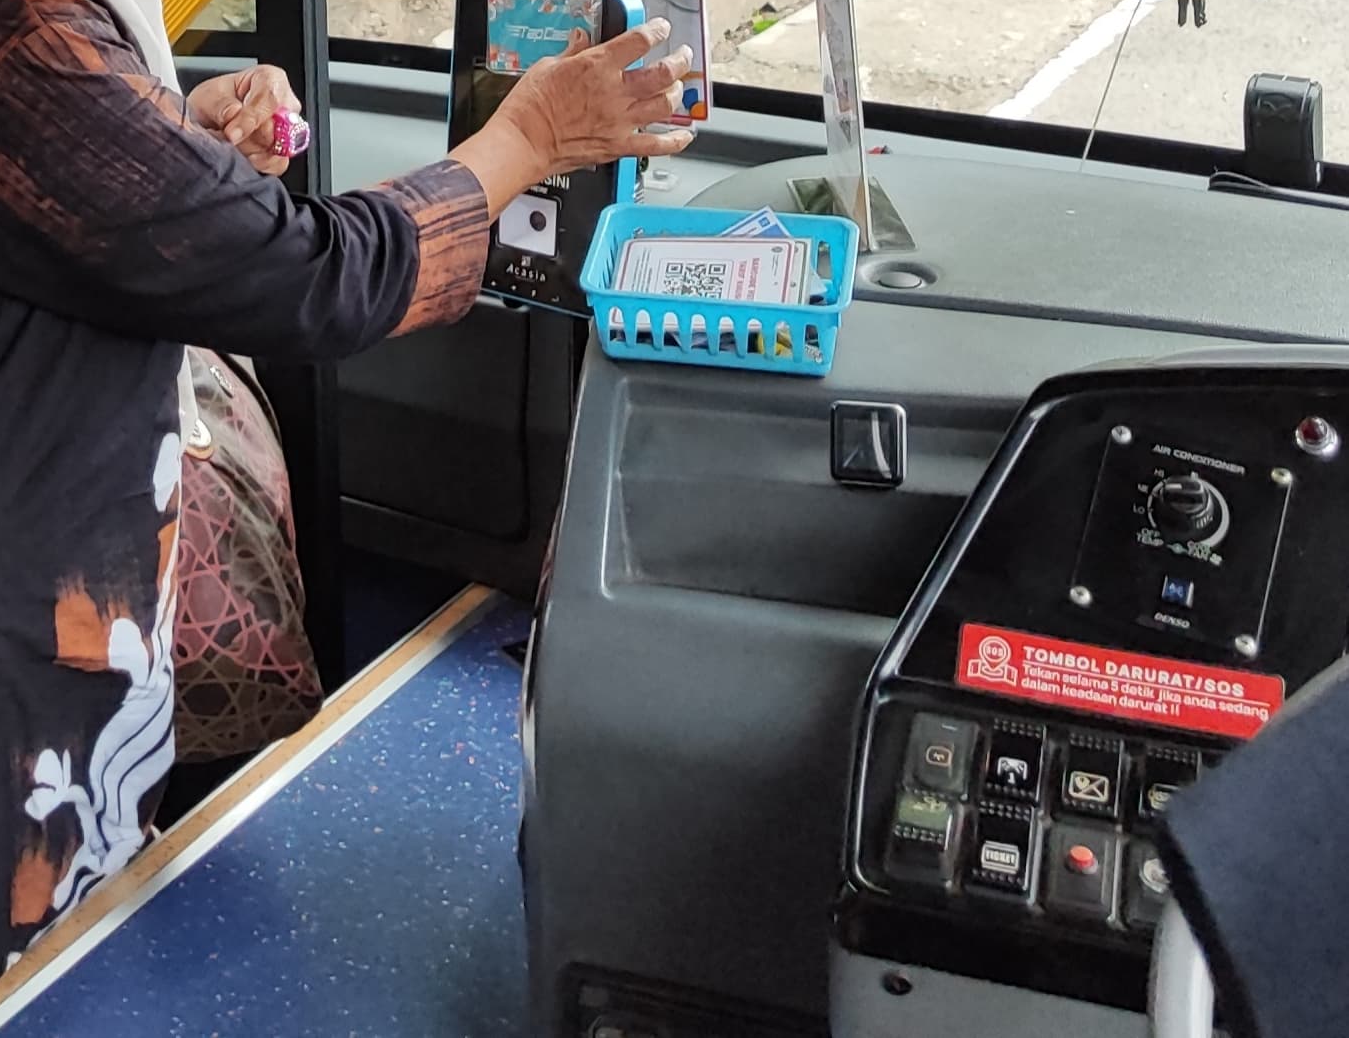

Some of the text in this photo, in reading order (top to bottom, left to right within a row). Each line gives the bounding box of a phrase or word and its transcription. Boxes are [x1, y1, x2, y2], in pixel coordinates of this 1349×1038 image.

[506, 263, 547, 283] Acasia
[1152, 444, 1246, 476] AIR CONDITIONER
[1153, 612, 1191, 629] DENSO
[1023, 646, 1244, 698] TOMBOL DARURAT/SOS
[1021, 676, 1061, 696] dalam
[1062, 684, 1118, 707] keadaan
[1119, 694, 1169, 715] darurat
[1023, 663, 1270, 723] Tekan selama 5 detik jika anda sedang
